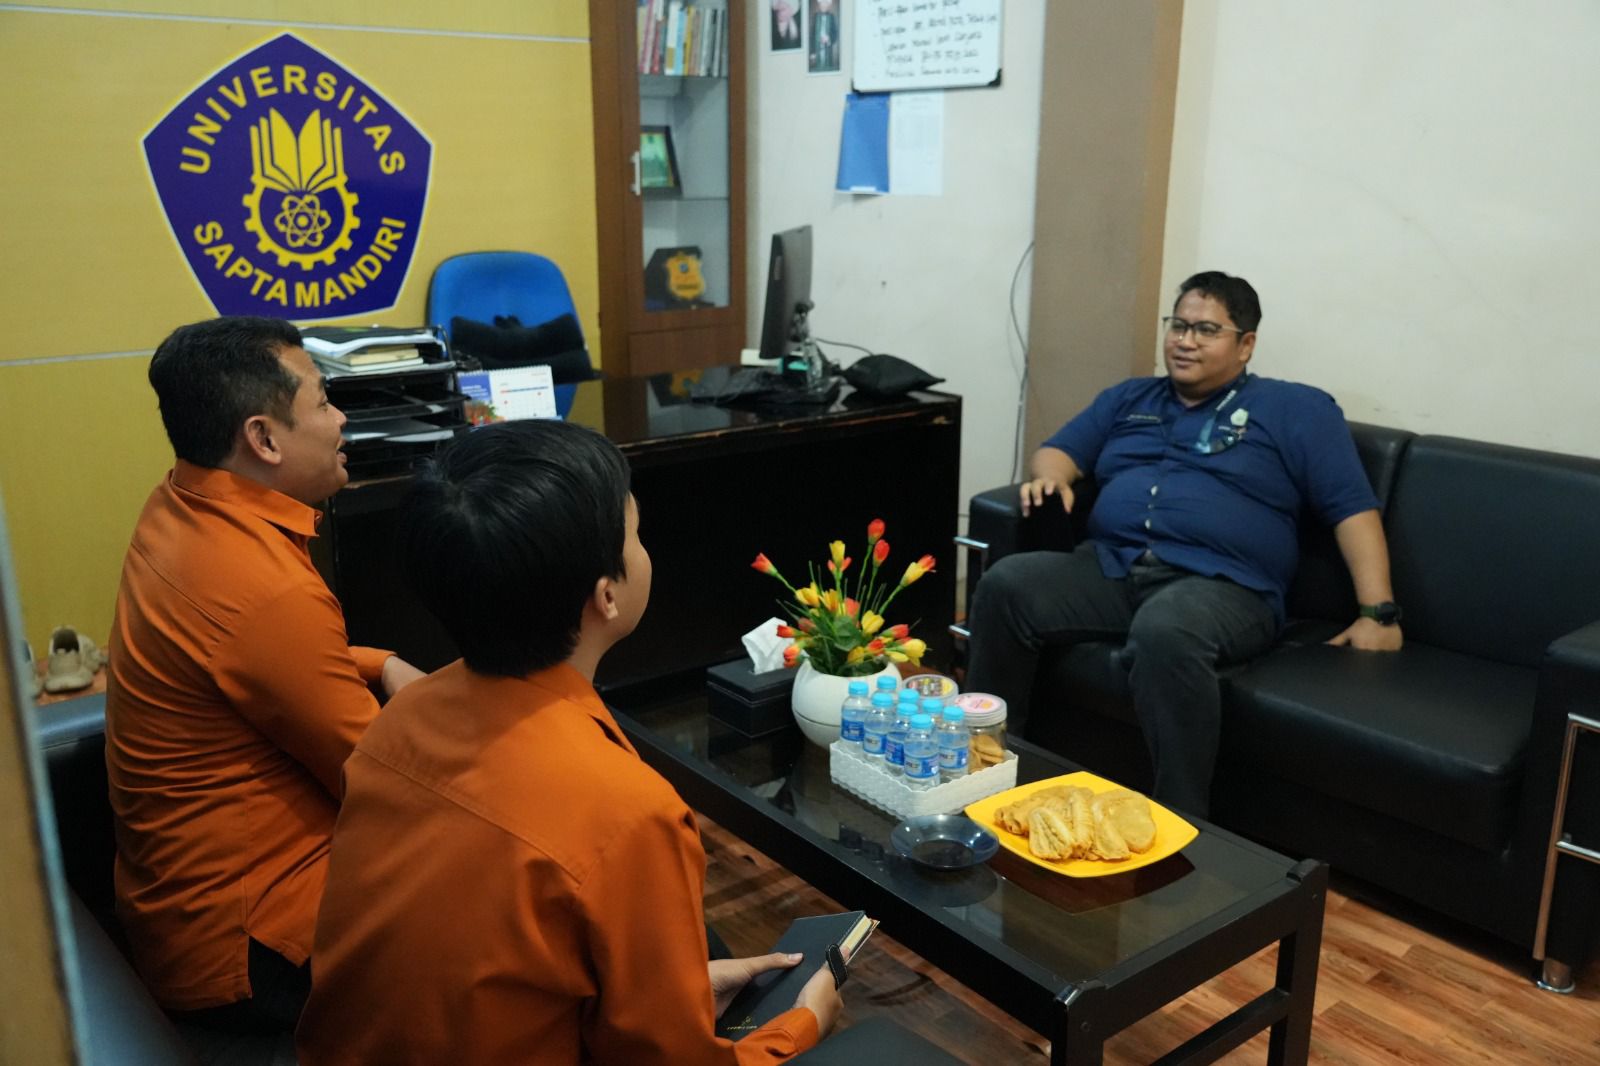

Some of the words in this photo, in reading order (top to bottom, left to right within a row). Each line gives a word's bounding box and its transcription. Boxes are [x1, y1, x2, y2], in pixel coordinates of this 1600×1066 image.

[180, 64, 405, 175] UNIVERSITAS
[194, 221, 288, 306] SAPTA
[295, 217, 406, 308] MANDIRI
